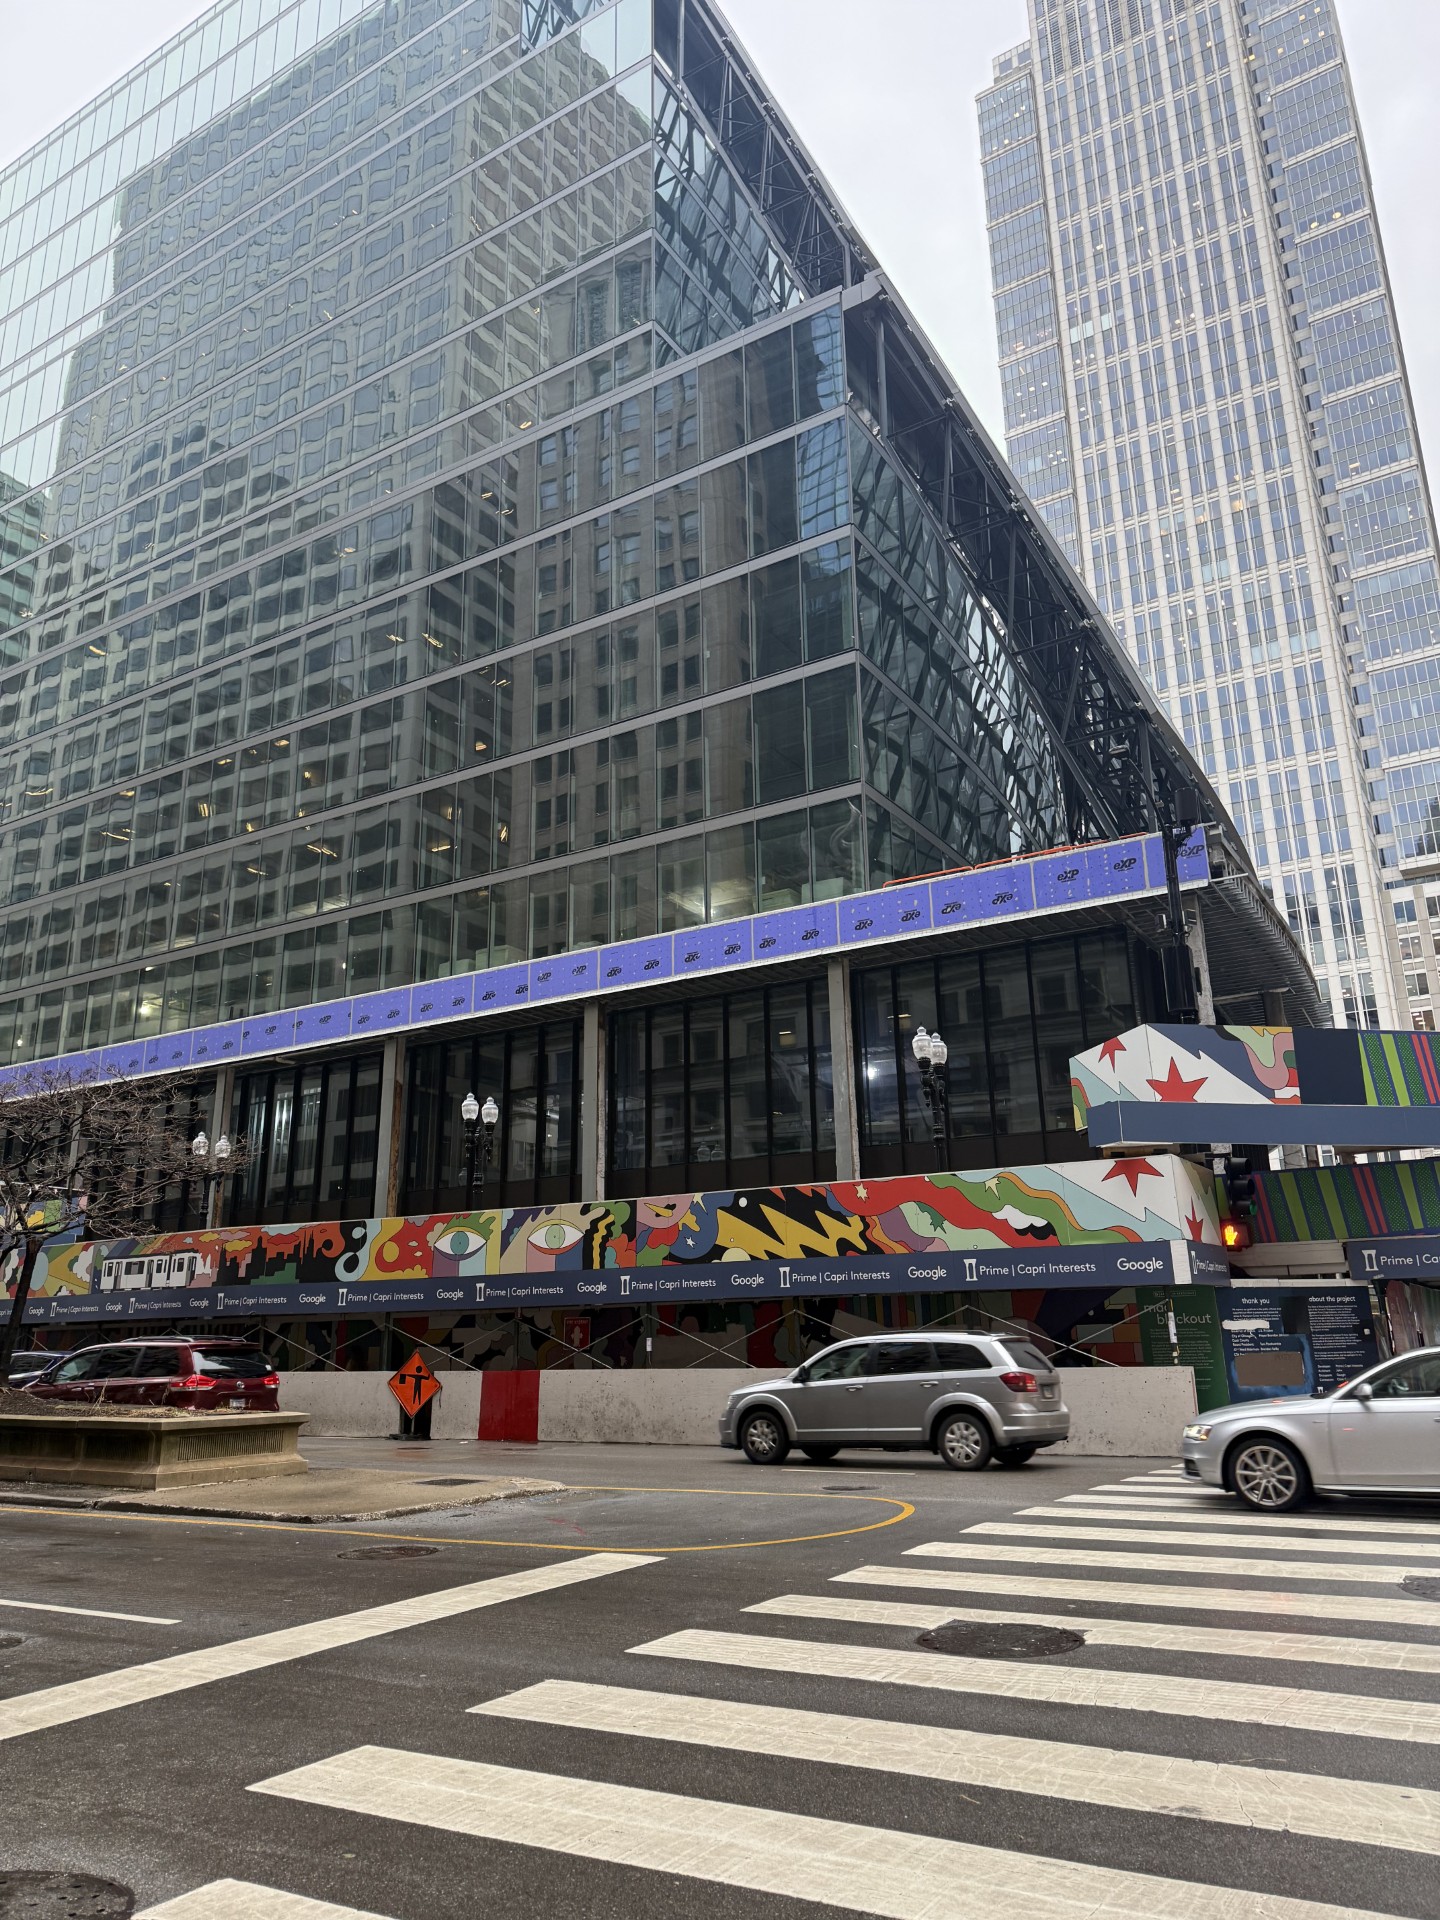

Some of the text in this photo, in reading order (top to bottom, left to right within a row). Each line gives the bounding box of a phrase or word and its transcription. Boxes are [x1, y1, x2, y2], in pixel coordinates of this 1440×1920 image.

[1180, 844, 1204, 858] eXP
[1114, 858, 1136, 870] eXP
[1057, 869, 1080, 882] eXP
[1117, 1257, 1164, 1272] Google
[1380, 1256, 1413, 1265] Prime
[1422, 1254, 1440, 1264] Ca
[908, 1266, 947, 1280] Google
[980, 1265, 1009, 1275] Prime
[1017, 1264, 1046, 1276] Capri
[1049, 1263, 1096, 1273] Interests
[731, 1274, 765, 1287] Google
[792, 1273, 817, 1282] Prime
[824, 1272, 848, 1283] Capri
[850, 1271, 890, 1280] Interests
[577, 1282, 607, 1294] Google
[631, 1281, 653, 1290] Prime
[660, 1280, 680, 1290] Capri
[682, 1279, 716, 1288] Interests
[348, 1294, 367, 1302] Prime
[373, 1293, 392, 1302] Capri
[394, 1292, 424, 1300] Interests
[436, 1289, 464, 1300] Google
[486, 1289, 506, 1297] Prime
[511, 1287, 531, 1297] Capri
[190, 1298, 209, 1308] Google
[243, 1297, 258, 1306] Capri
[299, 1294, 326, 1305] Google
[28, 1306, 45, 1316] Google
[106, 1302, 122, 1312] Google
[1157, 1312, 1212, 1324] blckout
